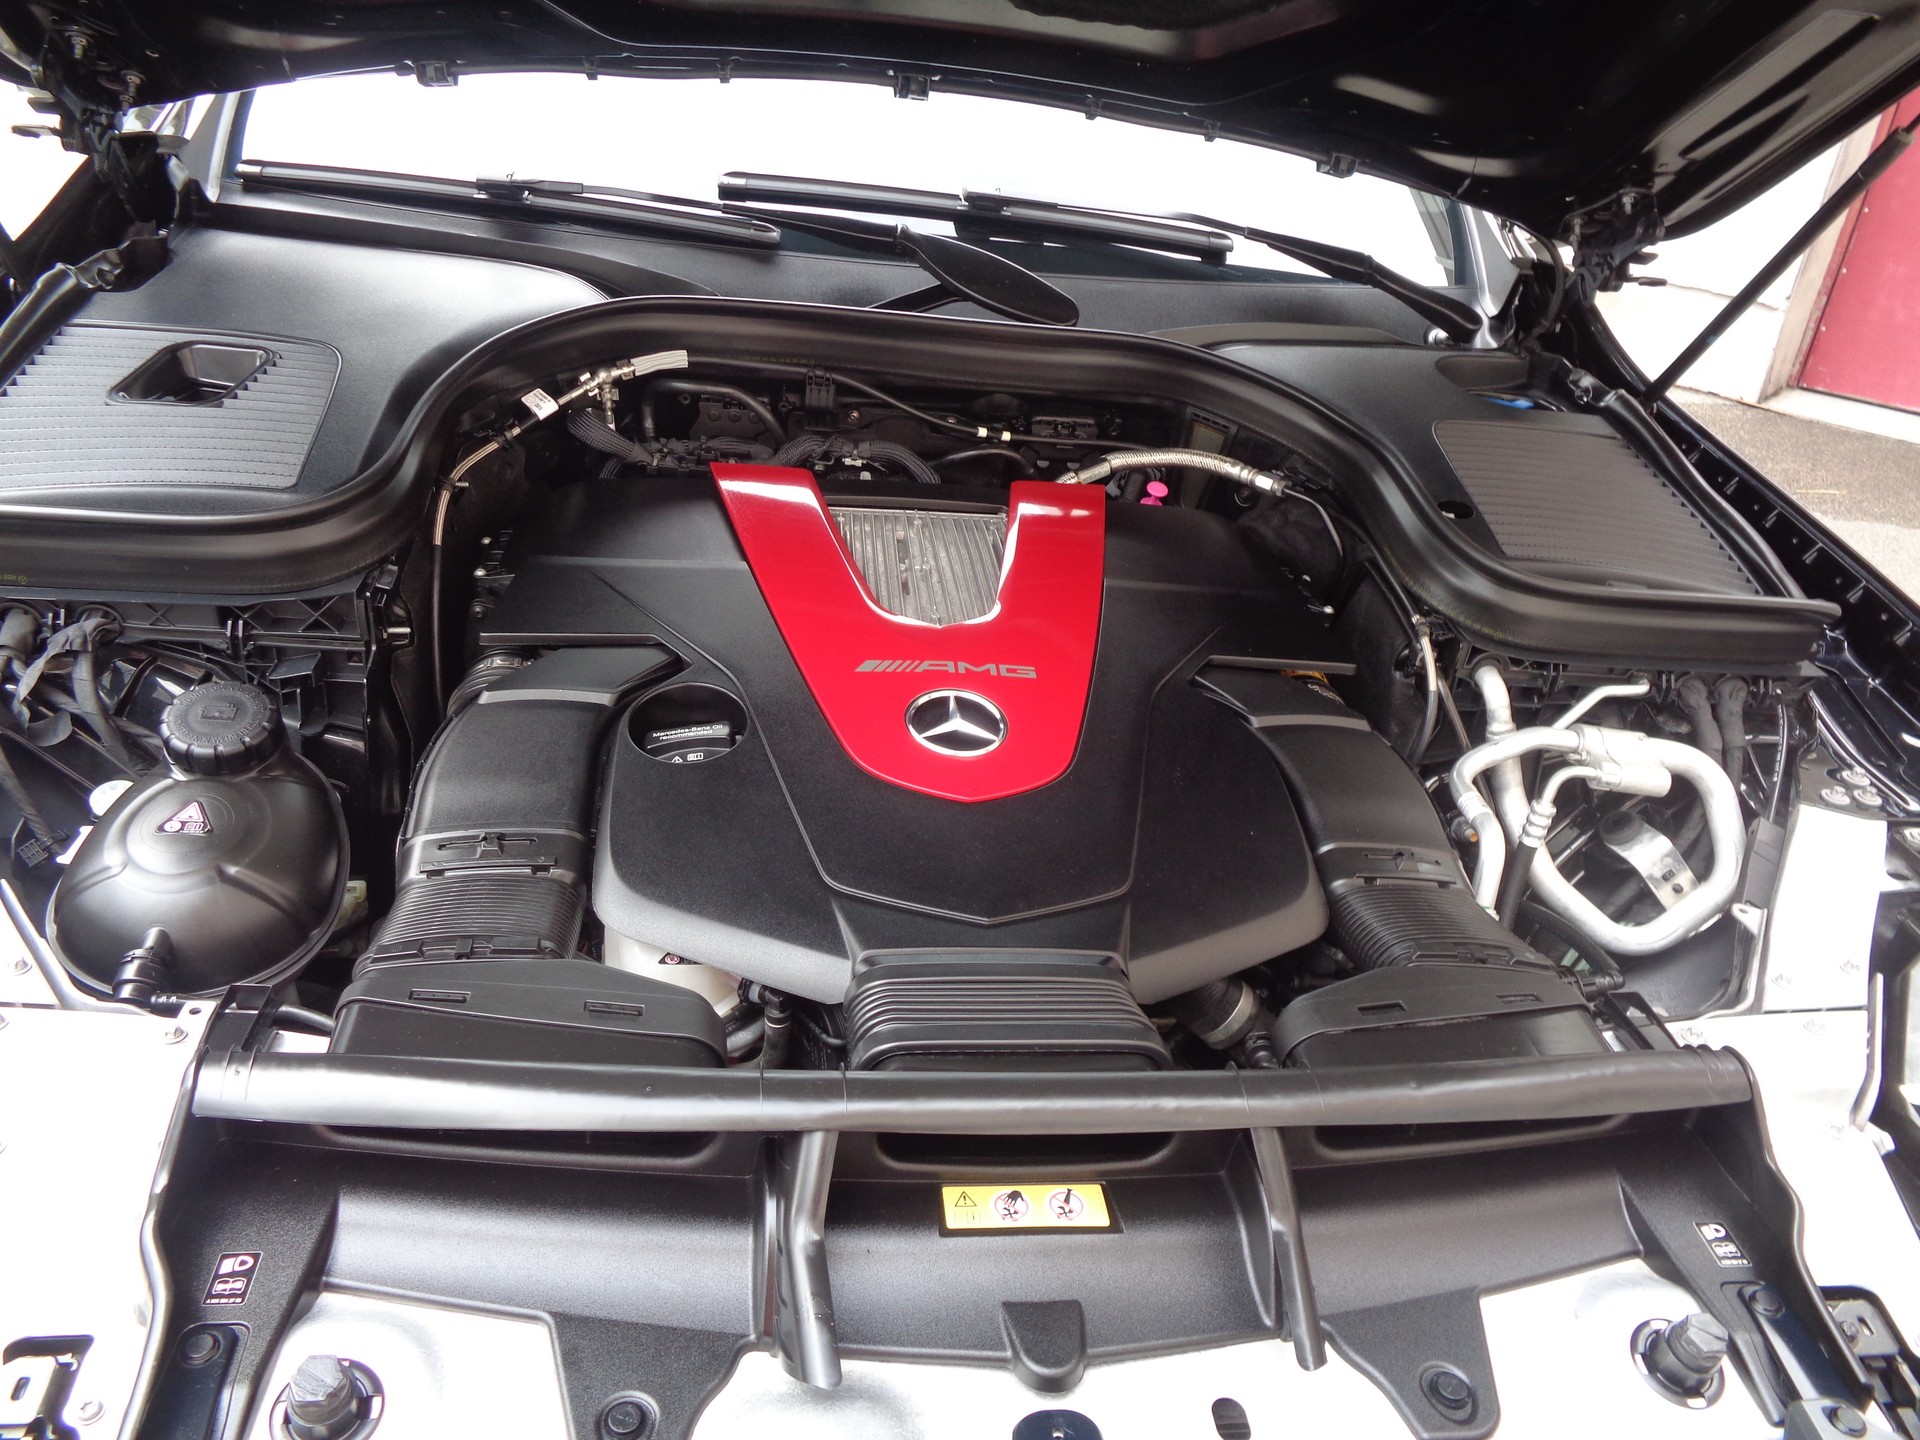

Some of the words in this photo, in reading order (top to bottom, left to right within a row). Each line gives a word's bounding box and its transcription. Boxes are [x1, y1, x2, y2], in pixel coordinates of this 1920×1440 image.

[913, 660, 1038, 679] AMG
[210, 684, 235, 693] OPEN
[652, 725, 711, 738] Mercedes-Benz
[659, 729, 713, 741] recommended
